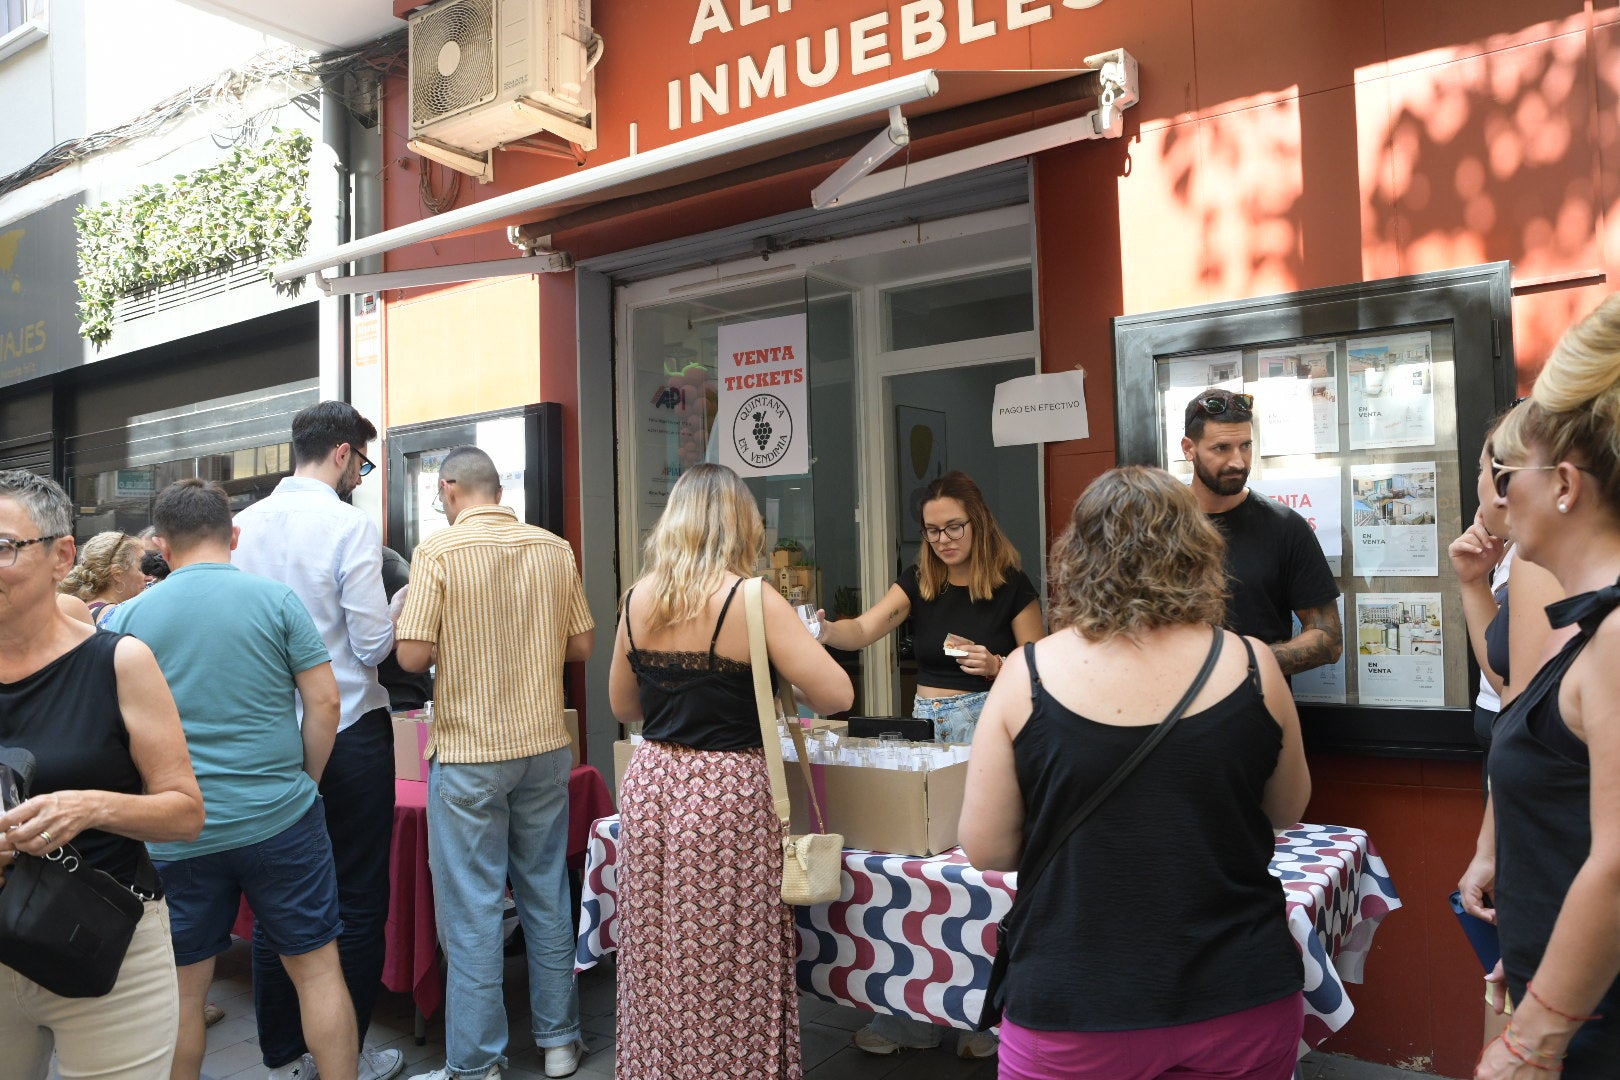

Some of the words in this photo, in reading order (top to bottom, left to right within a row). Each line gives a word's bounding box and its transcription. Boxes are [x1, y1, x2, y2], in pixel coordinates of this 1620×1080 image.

[689, 0, 792, 45] AL
[668, 0, 1105, 131] INMUEBLE
[733, 345, 795, 367] VENTA
[725, 368, 803, 391] TICKETS
[740, 397, 785, 421] QUINTANA
[999, 405, 1023, 416] PAGO
[1024, 405, 1036, 413] EN
[1038, 400, 1080, 412] EFECTIVO
[738, 437, 749, 454] EN
[750, 434, 788, 464] VENDIMIA
